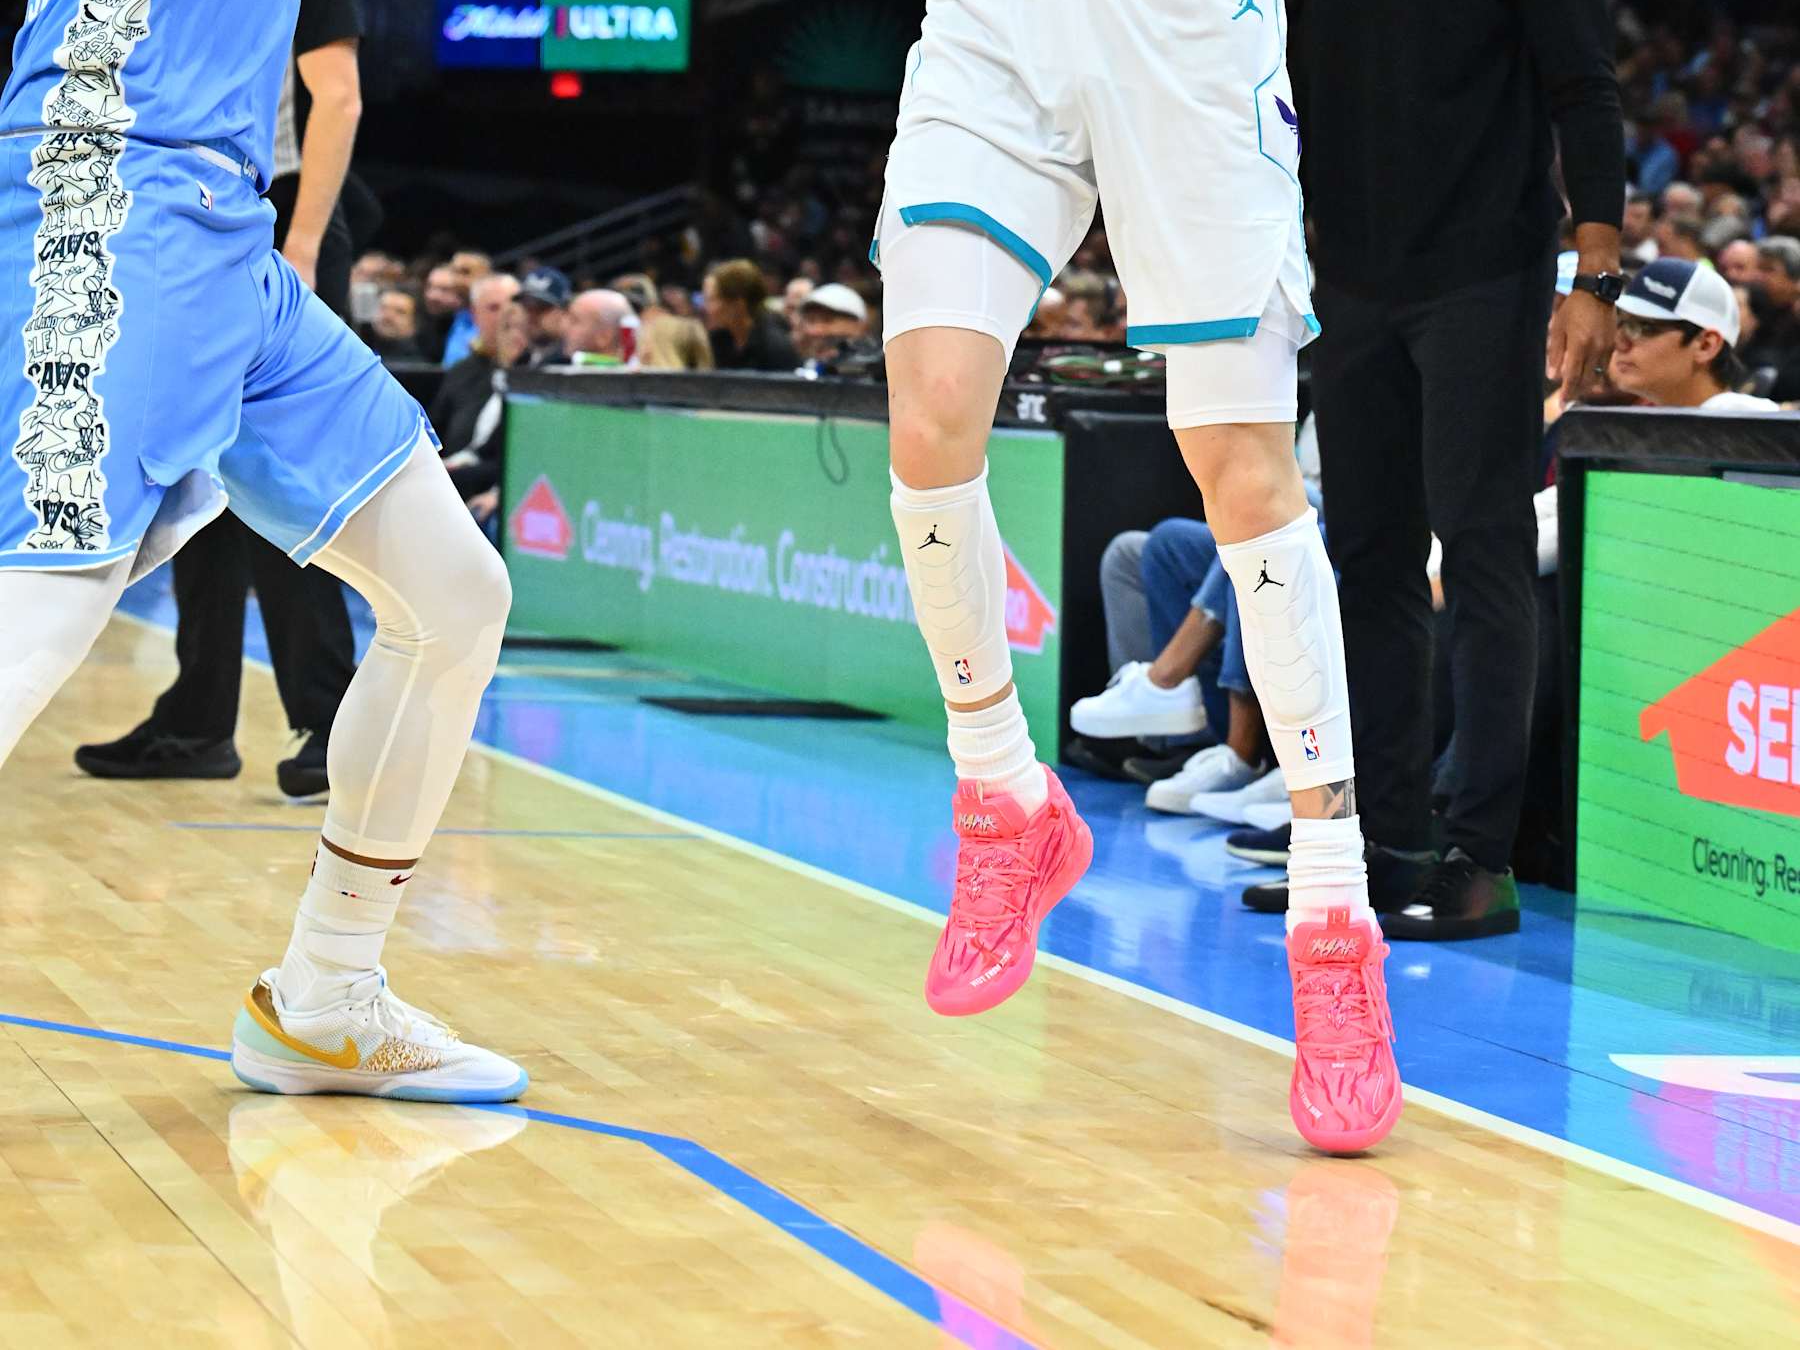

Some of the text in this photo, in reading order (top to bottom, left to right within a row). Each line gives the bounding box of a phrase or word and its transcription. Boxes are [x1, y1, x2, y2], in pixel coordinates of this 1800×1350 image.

[569, 4, 678, 41] ULTRA
[1725, 679, 1800, 786] SE
[1692, 835, 1770, 897] Cleaning.
